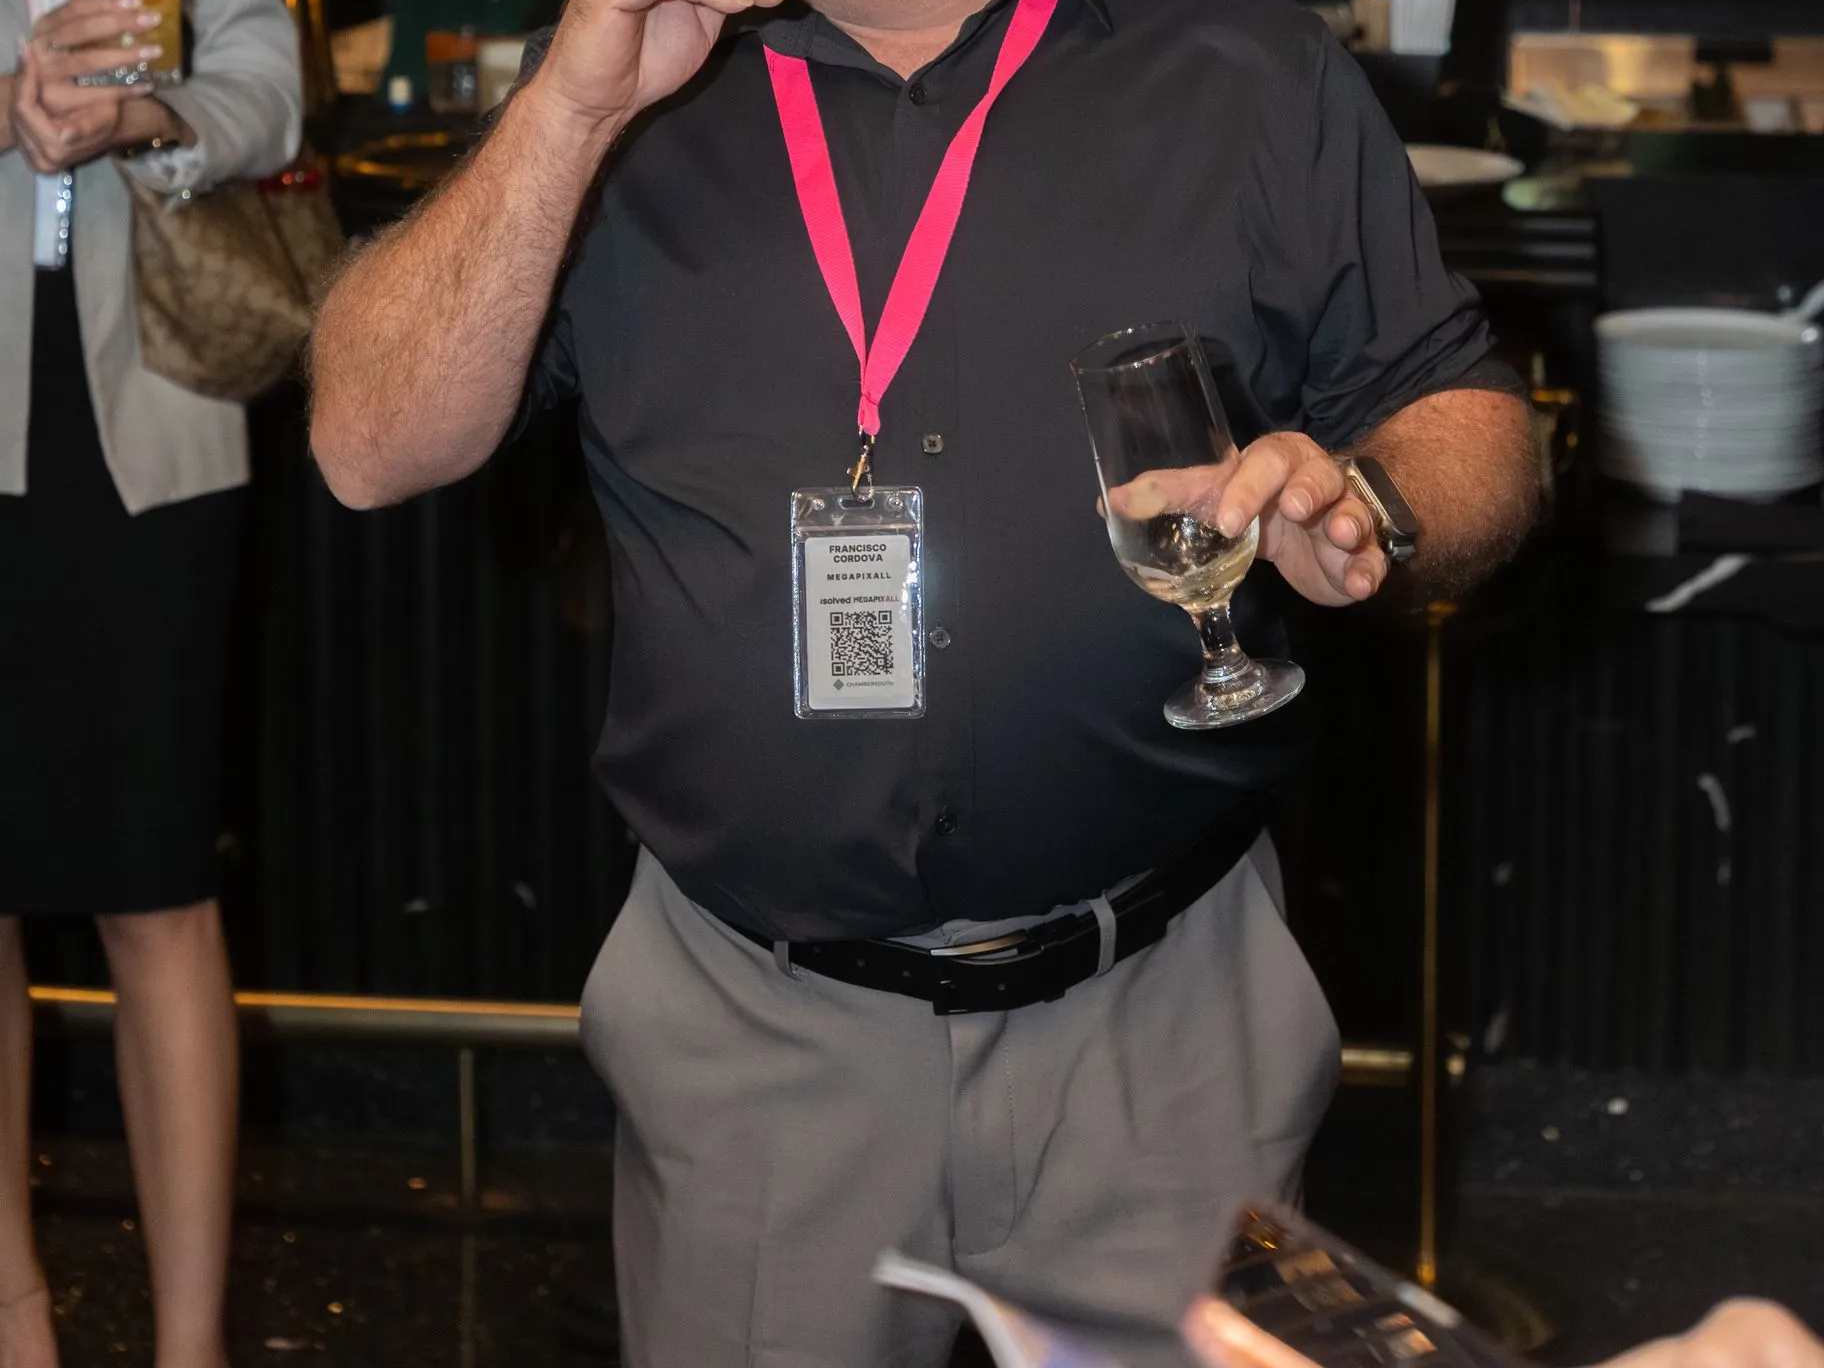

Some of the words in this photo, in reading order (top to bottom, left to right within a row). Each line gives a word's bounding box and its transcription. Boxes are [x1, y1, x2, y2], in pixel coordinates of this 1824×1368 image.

[829, 543, 887, 553] FRANCISCO
[833, 554, 883, 563] CORDOVA
[827, 572, 892, 581] MEGAPIXALL
